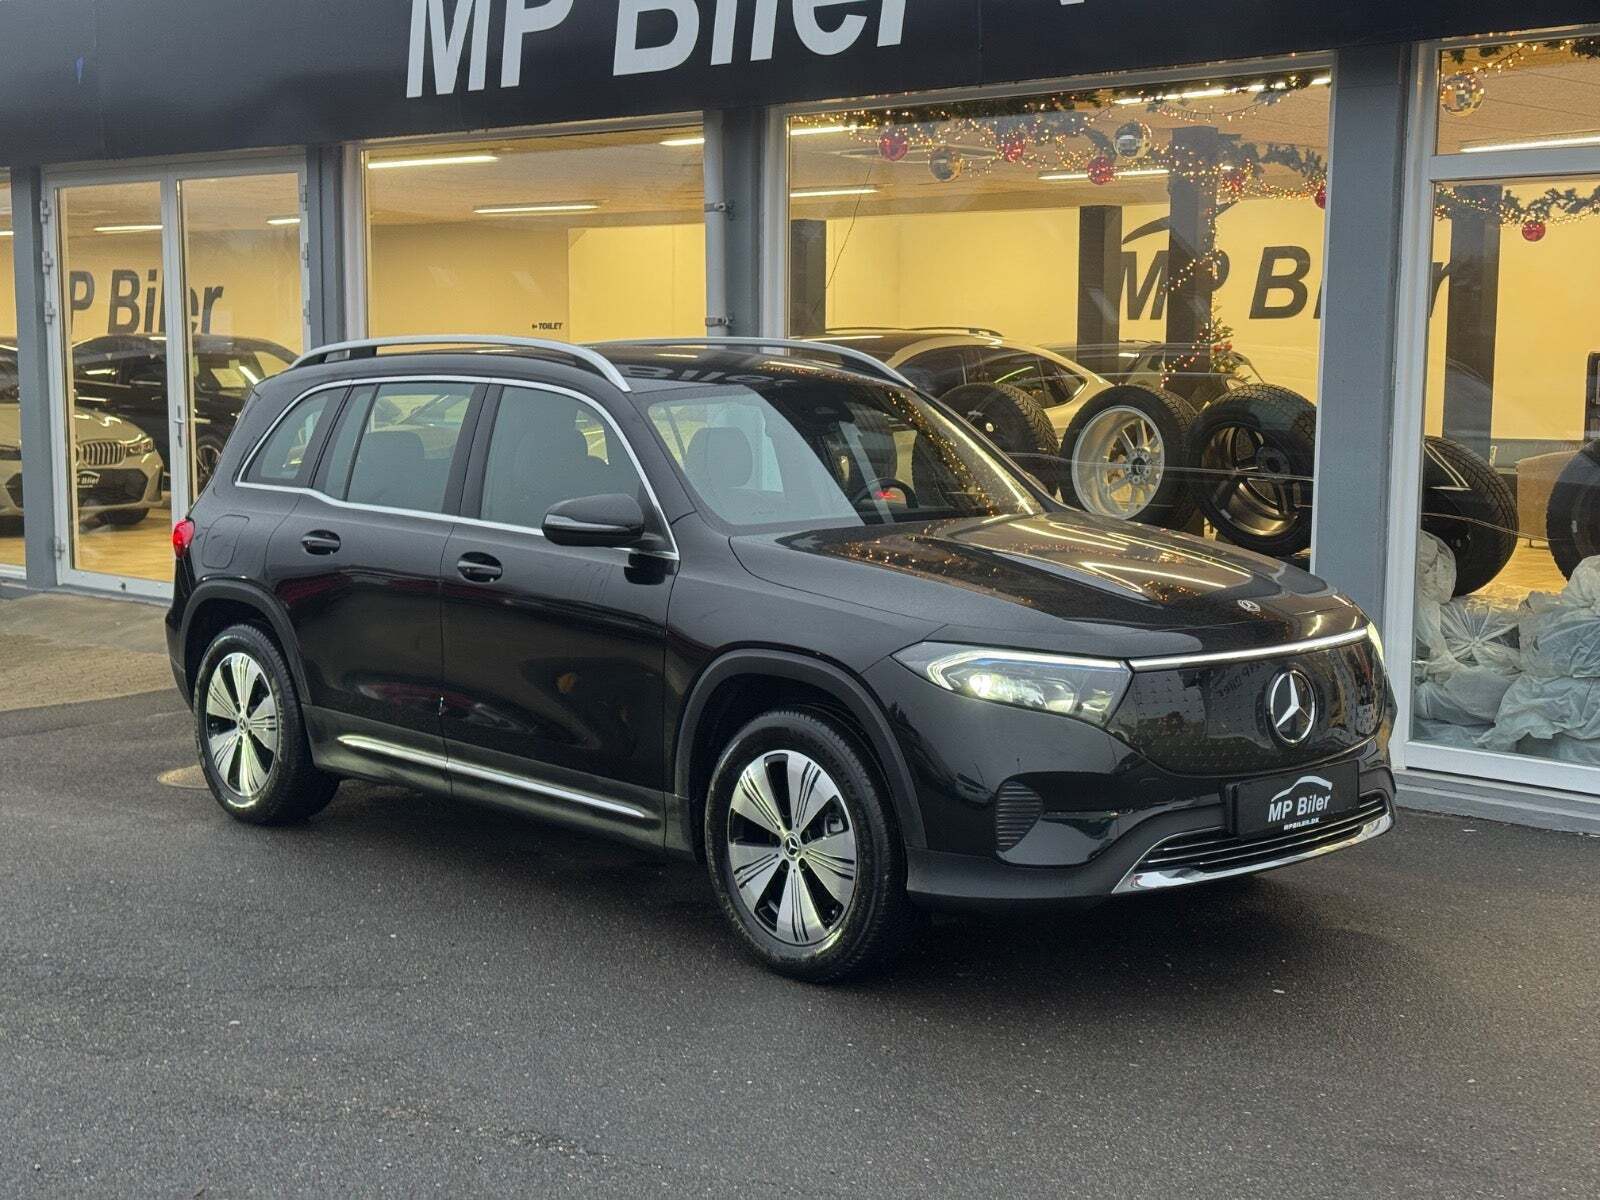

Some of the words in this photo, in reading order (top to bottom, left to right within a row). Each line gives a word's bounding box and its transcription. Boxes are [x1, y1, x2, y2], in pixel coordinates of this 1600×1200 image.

[407, 0, 574, 98] MP
[538, 322, 562, 330] TOILET
[1268, 800, 1293, 823] MP
[1297, 794, 1331, 816] Biler
